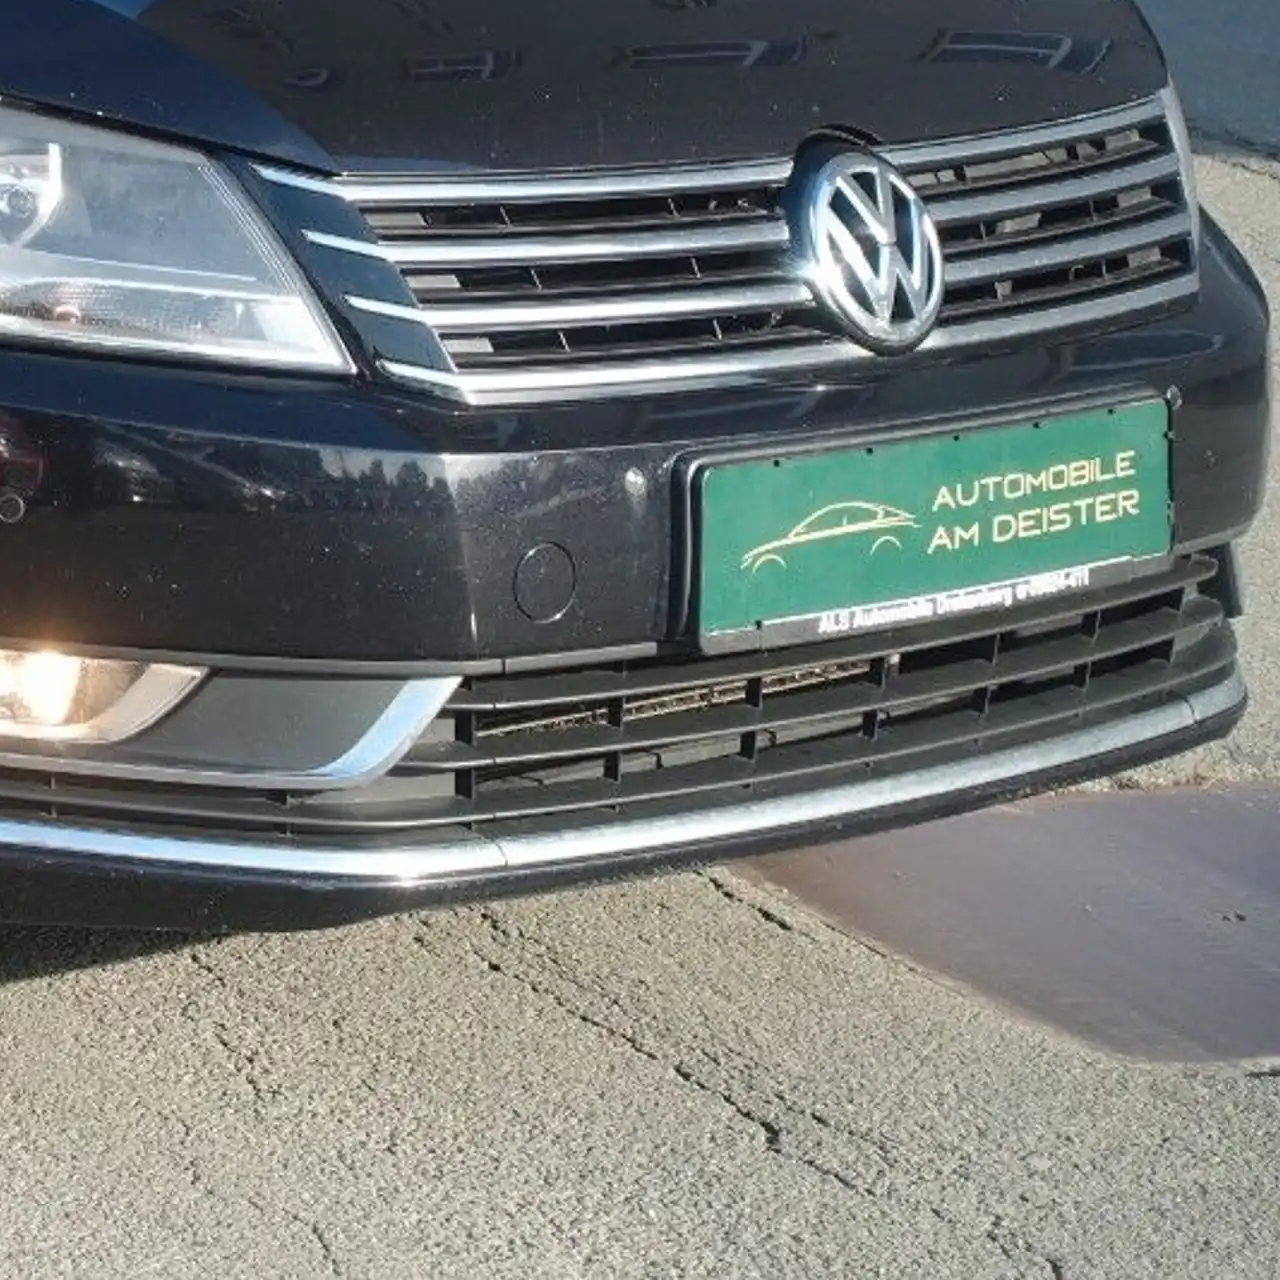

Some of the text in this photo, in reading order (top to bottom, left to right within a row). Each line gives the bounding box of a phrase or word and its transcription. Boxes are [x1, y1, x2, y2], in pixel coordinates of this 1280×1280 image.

[931, 449, 1137, 513] AUTOMOBILE
[926, 488, 1141, 555] AM DEISTER
